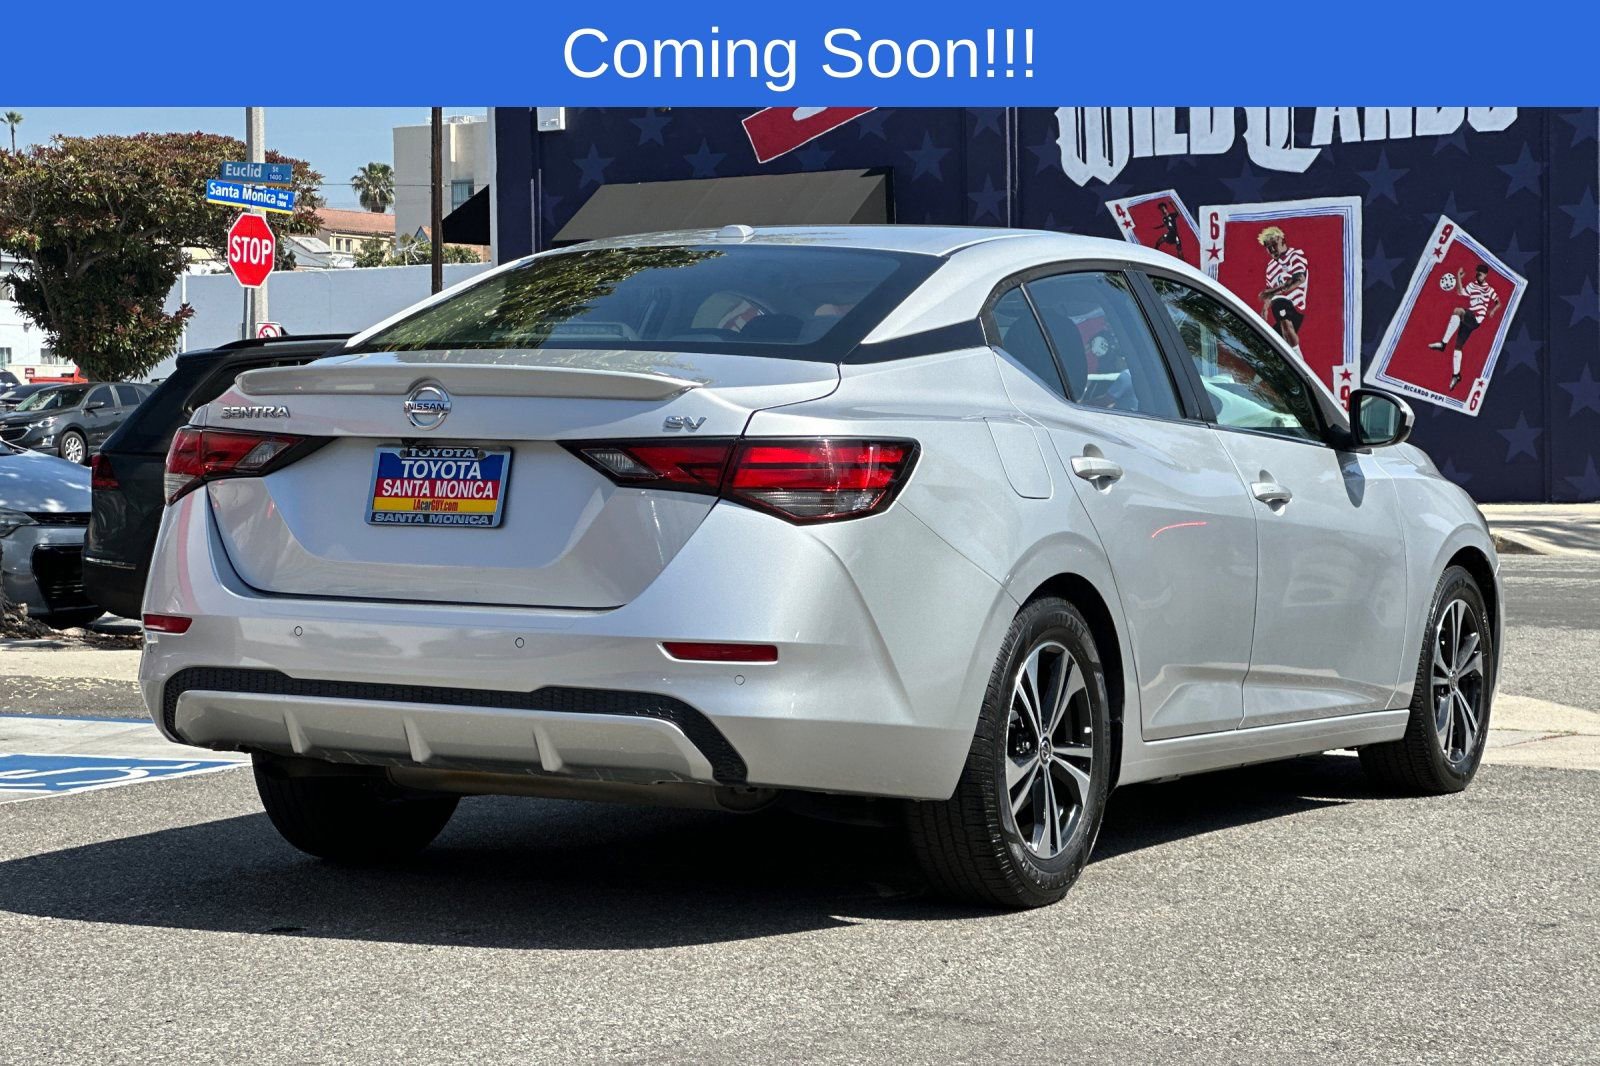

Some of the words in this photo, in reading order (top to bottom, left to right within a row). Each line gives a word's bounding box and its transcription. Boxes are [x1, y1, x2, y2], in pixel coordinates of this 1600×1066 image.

[225, 163, 262, 178] Euclid
[209, 182, 240, 199] Santa
[242, 187, 276, 204] Monica
[1114, 203, 1126, 218] 4
[1210, 212, 1220, 240] 6
[1438, 223, 1454, 244] 9
[231, 235, 272, 265] STOP
[1403, 384, 1429, 397] RICARDO
[1430, 393, 1444, 402] PEPI
[221, 405, 291, 419] SENTRA
[407, 402, 445, 411] NISSAN
[662, 415, 707, 433] SV
[409, 447, 475, 458] TOYOTA
[401, 460, 482, 479] TOYOTA
[382, 479, 430, 497] SANTA
[434, 480, 493, 498] MONICA
[413, 499, 458, 511] LAcarGUY.com
[374, 512, 425, 523] SANTA
[429, 513, 489, 525] MONICA
